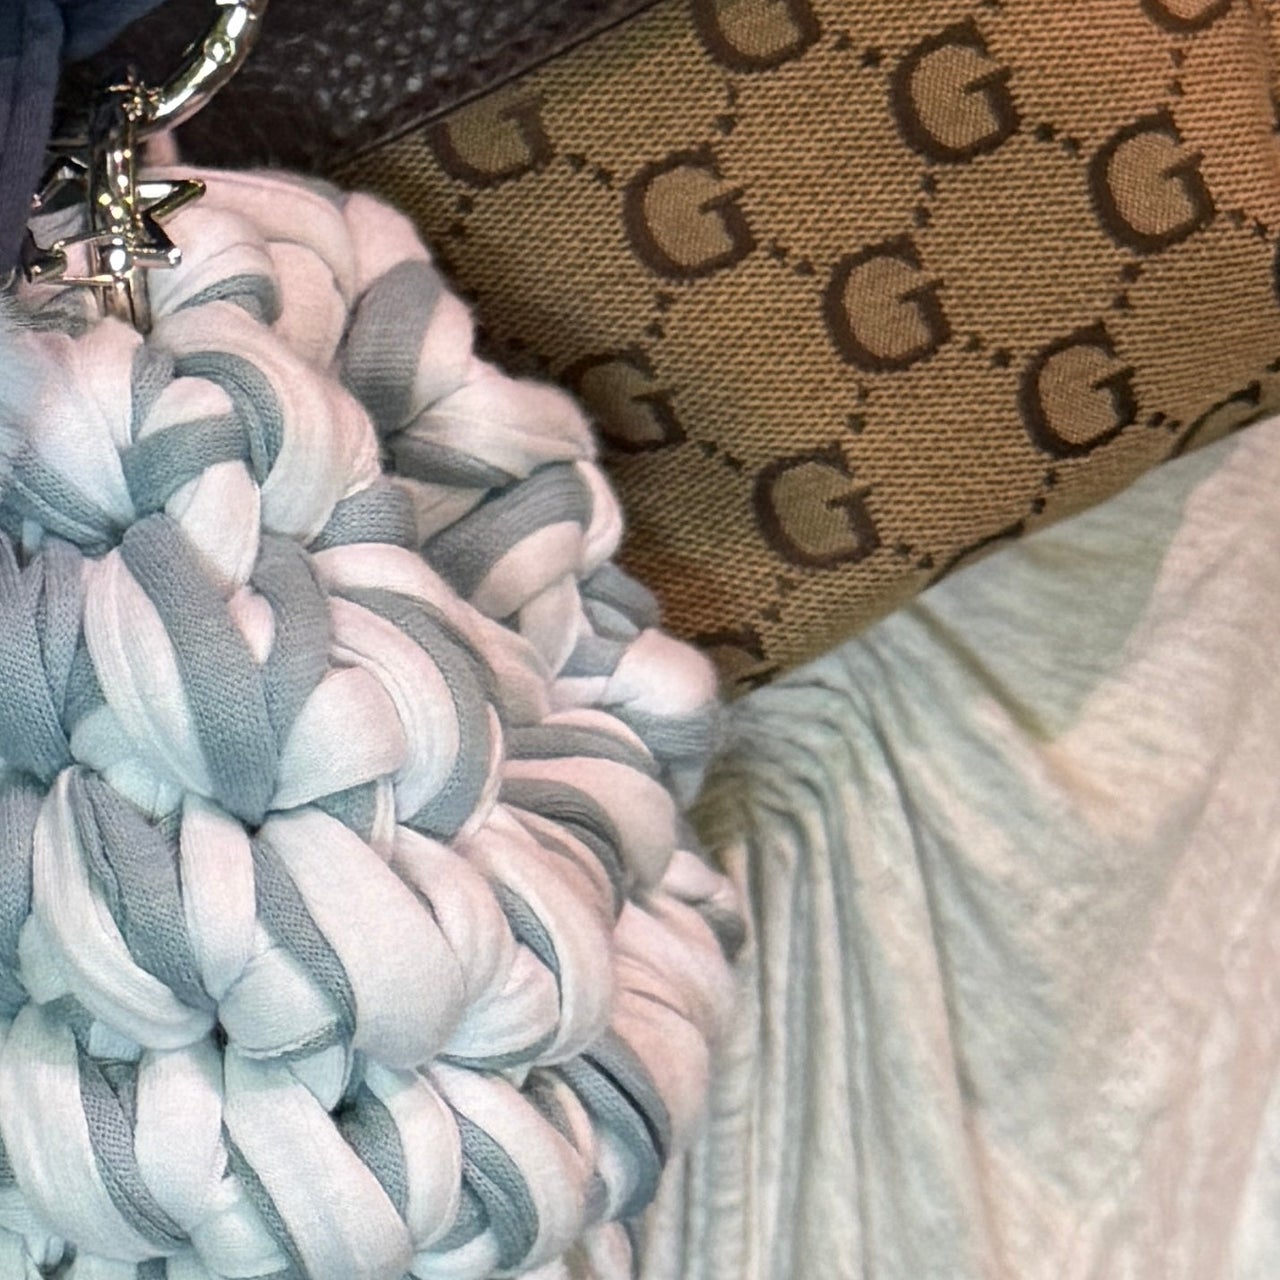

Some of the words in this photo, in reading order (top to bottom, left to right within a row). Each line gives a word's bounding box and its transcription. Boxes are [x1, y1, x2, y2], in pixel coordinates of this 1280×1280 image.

[891, 21, 1021, 163] G
[624, 142, 757, 283] G
[1089, 103, 1216, 255] G
[824, 234, 951, 371] G
[1018, 320, 1138, 459] G
[752, 440, 880, 571] G
